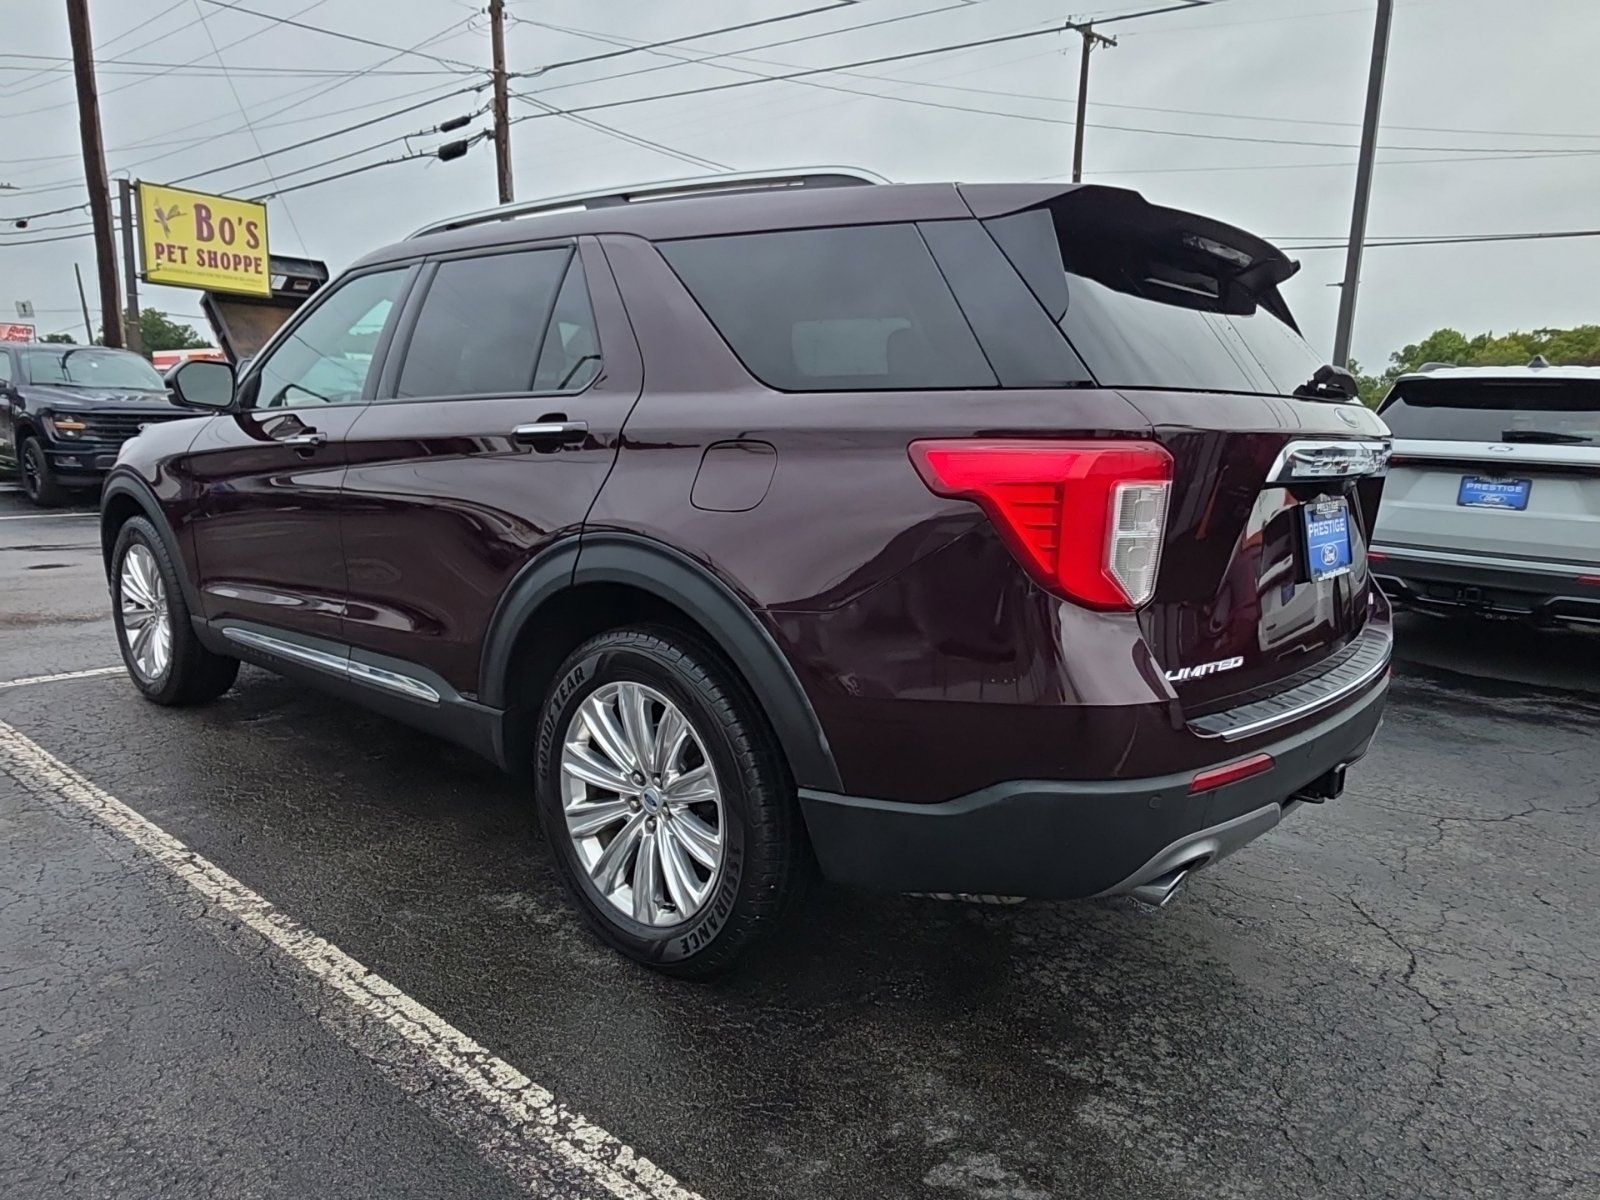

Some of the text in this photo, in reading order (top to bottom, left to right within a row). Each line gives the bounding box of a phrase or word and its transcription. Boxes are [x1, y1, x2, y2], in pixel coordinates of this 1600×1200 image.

[154, 242, 188, 265] PET
[196, 248, 263, 275] SHOPPE
[1466, 483, 1523, 492] PRESTIGE
[1308, 518, 1346, 538] PRESTIGE
[1164, 655, 1244, 682] LIMITED
